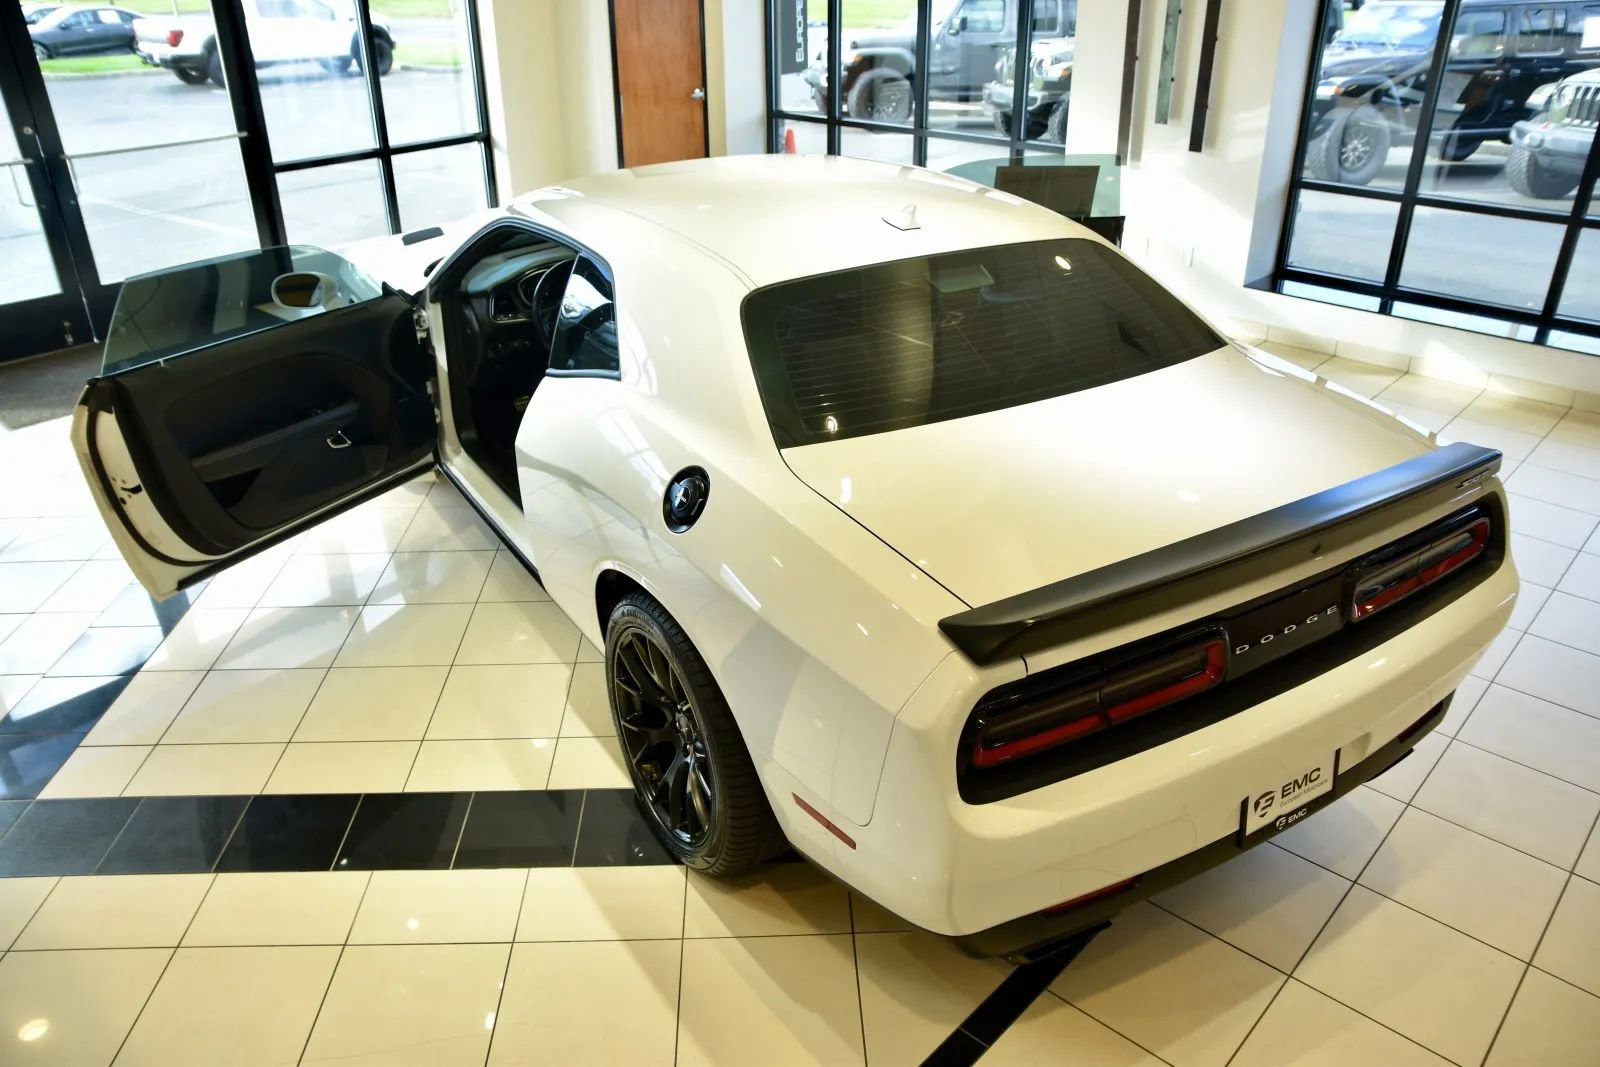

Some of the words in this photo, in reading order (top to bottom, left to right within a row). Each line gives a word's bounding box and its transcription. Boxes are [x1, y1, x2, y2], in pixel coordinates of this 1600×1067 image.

[1236, 605, 1338, 655] DODGE
[1281, 767, 1321, 799] EMC
[1288, 807, 1308, 824] EMC
